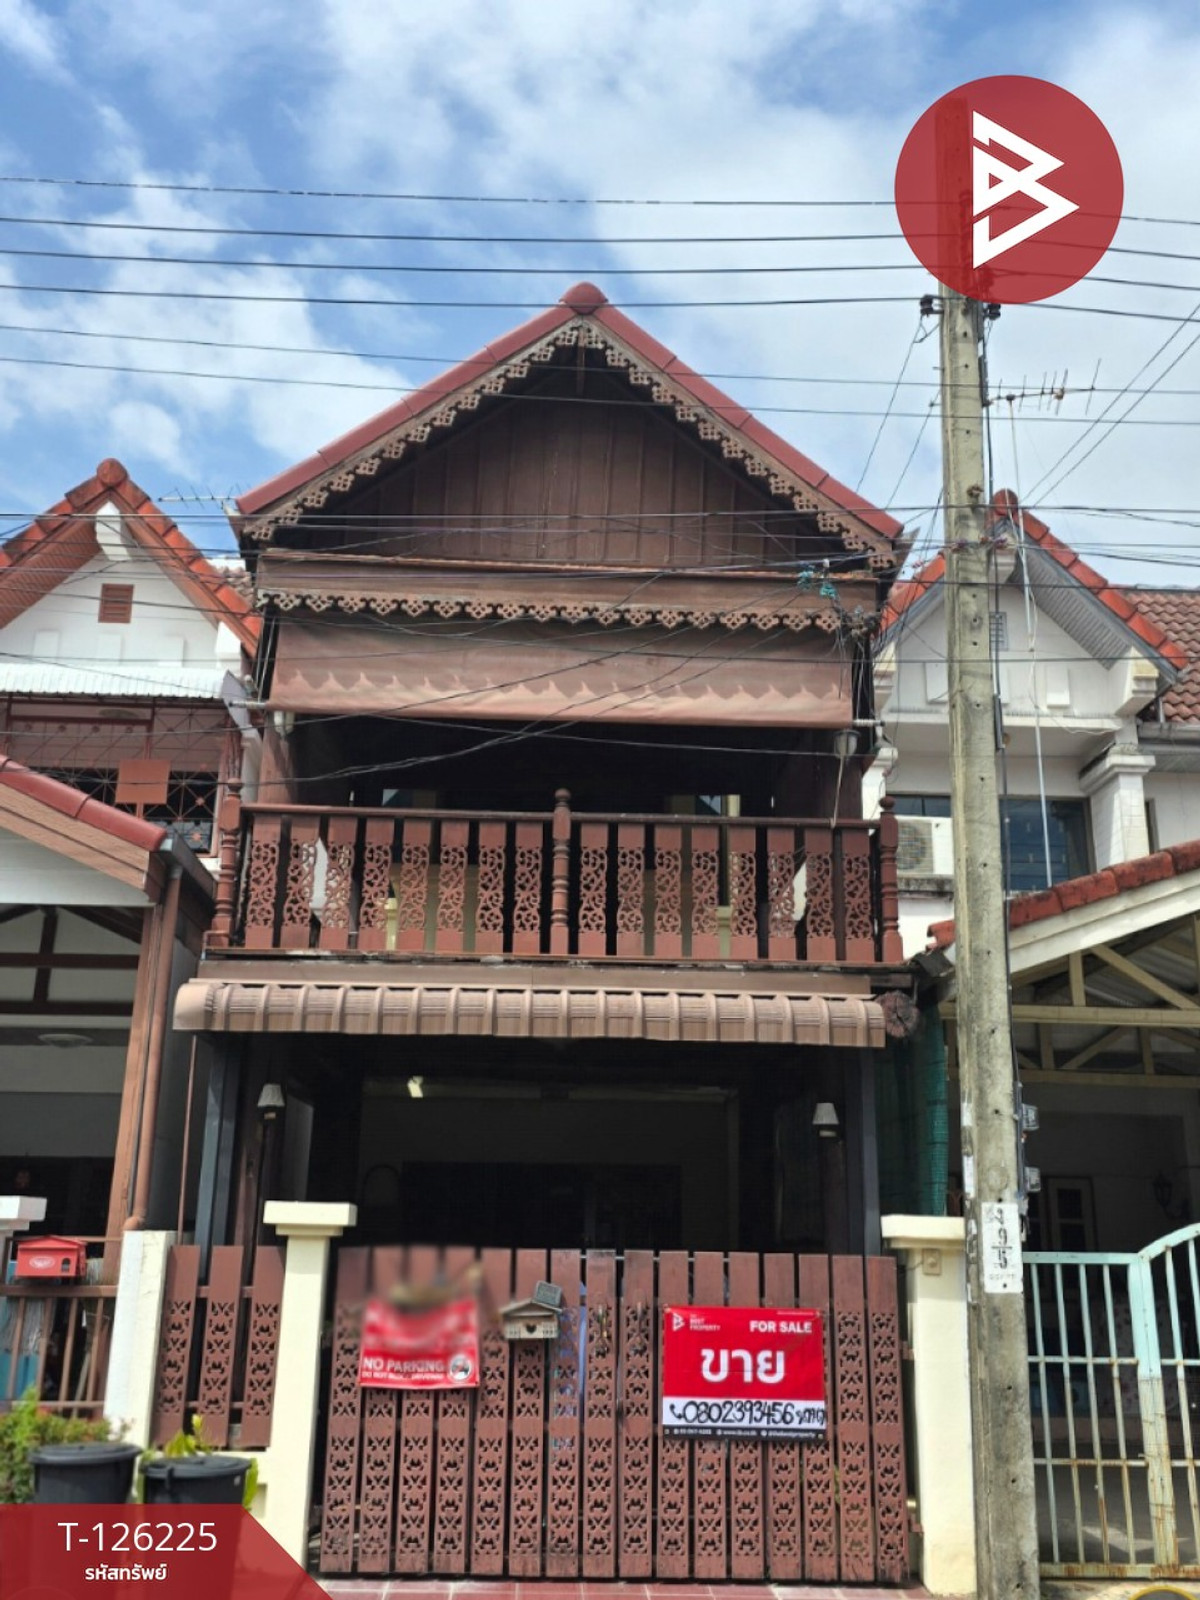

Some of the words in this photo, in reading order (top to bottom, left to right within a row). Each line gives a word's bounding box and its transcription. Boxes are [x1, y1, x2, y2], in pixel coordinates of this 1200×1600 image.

[749, 1320, 777, 1333] FOR
[779, 1321, 813, 1334] SALE
[363, 1357, 384, 1371] NO
[387, 1360, 445, 1373] PARKING
[701, 1348, 785, 1384] ขาย
[683, 1400, 795, 1425] 0802393456
